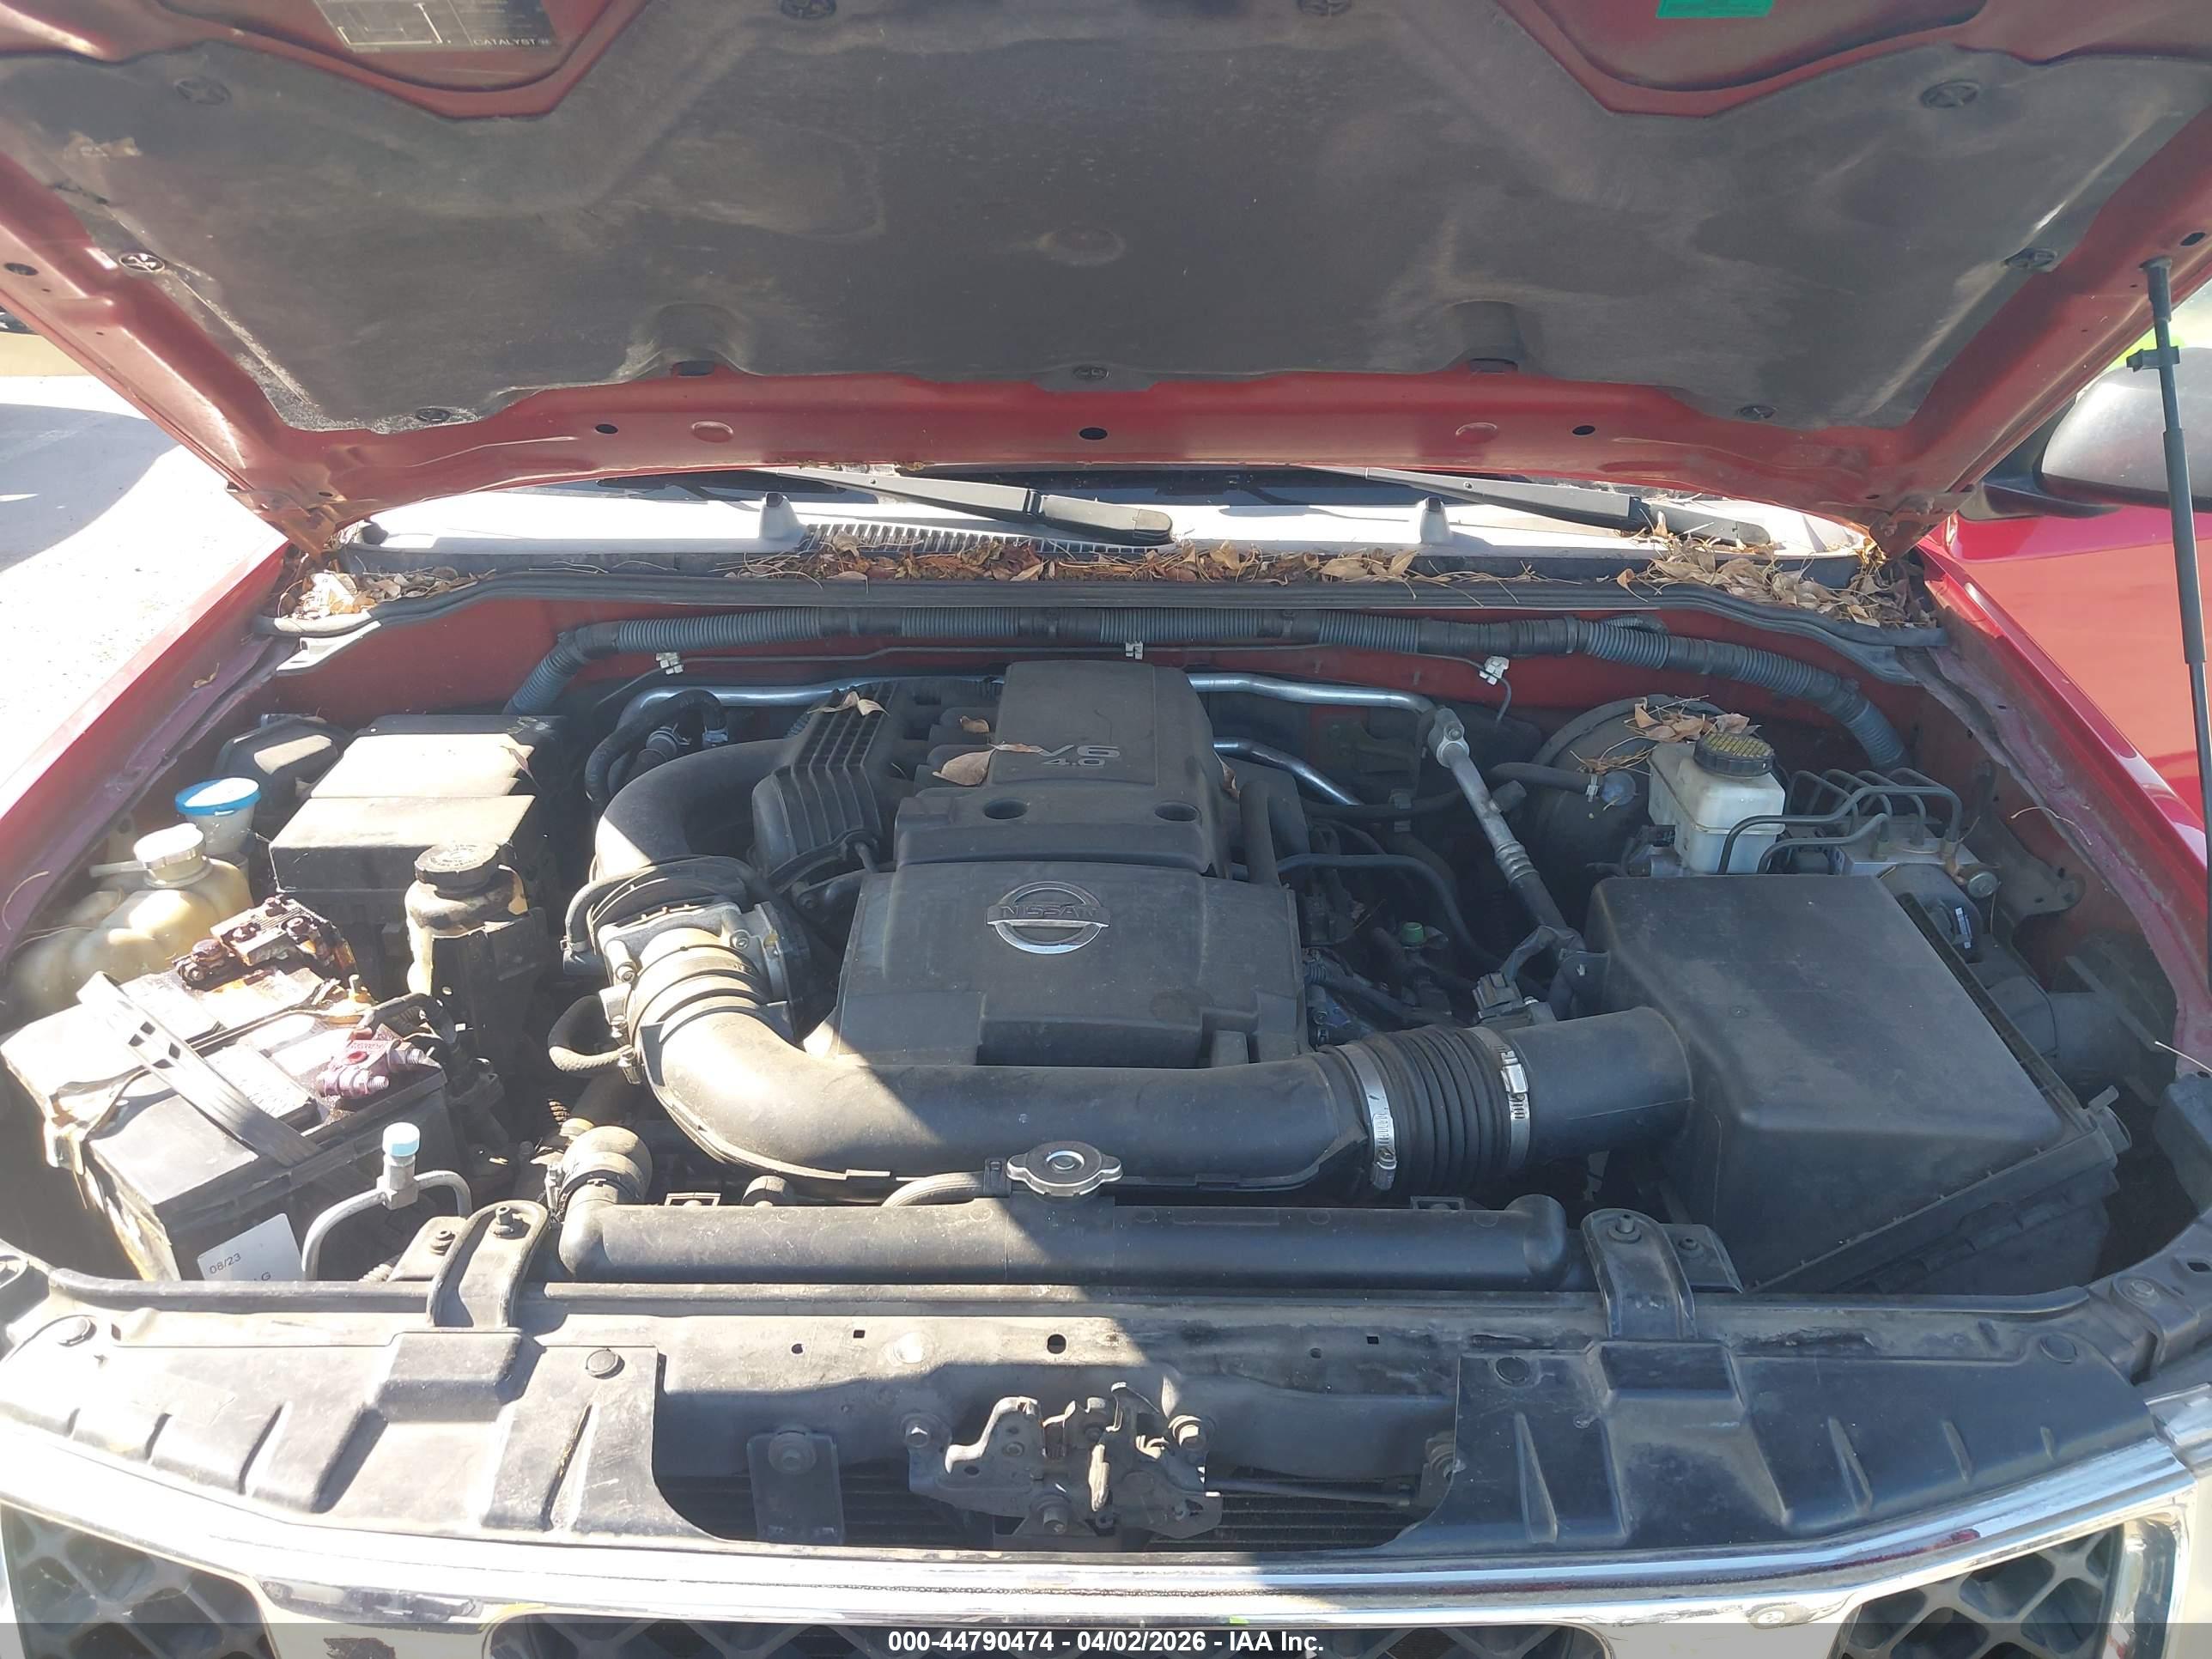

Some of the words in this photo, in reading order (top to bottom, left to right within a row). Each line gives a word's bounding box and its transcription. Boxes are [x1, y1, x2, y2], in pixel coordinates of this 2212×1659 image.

[1038, 744, 1121, 758] V6
[1042, 757, 1106, 767] 4.0
[1001, 905, 1097, 919] NISSAN
[210, 1253, 241, 1273] 08/23
